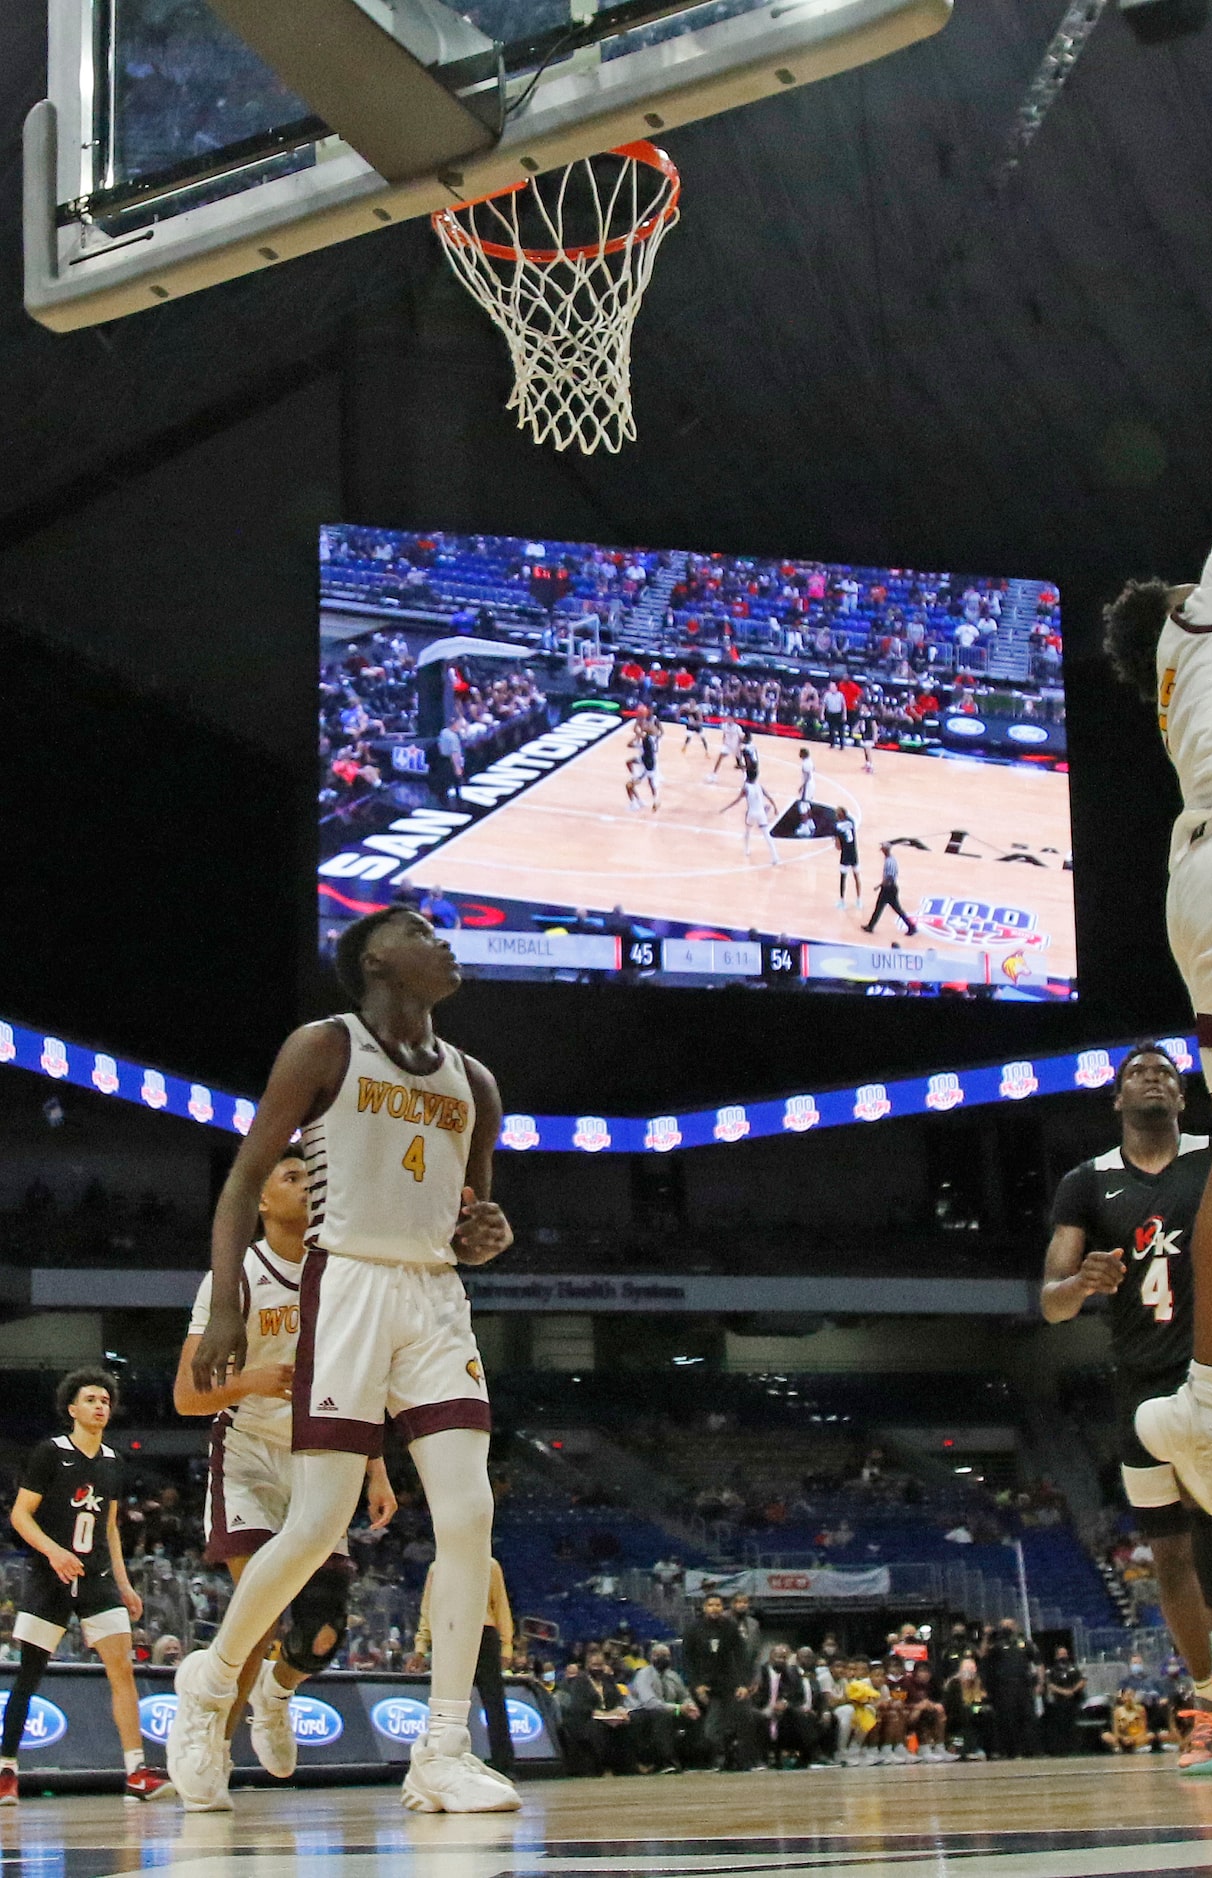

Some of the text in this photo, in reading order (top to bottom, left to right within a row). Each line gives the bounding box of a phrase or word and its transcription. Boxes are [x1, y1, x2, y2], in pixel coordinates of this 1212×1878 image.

[318, 712, 622, 880] SAN ANTONIO
[487, 938, 924, 971] KIMBALL 45 4 6:11 54 UNITED
[357, 1077, 469, 1133] WOLVES
[402, 1135, 426, 1182] 4
[1141, 1256, 1174, 1323] 4
[72, 1511, 96, 1554] 0
[289, 1705, 329, 1735] Ford
[388, 1706, 429, 1735] Ford
